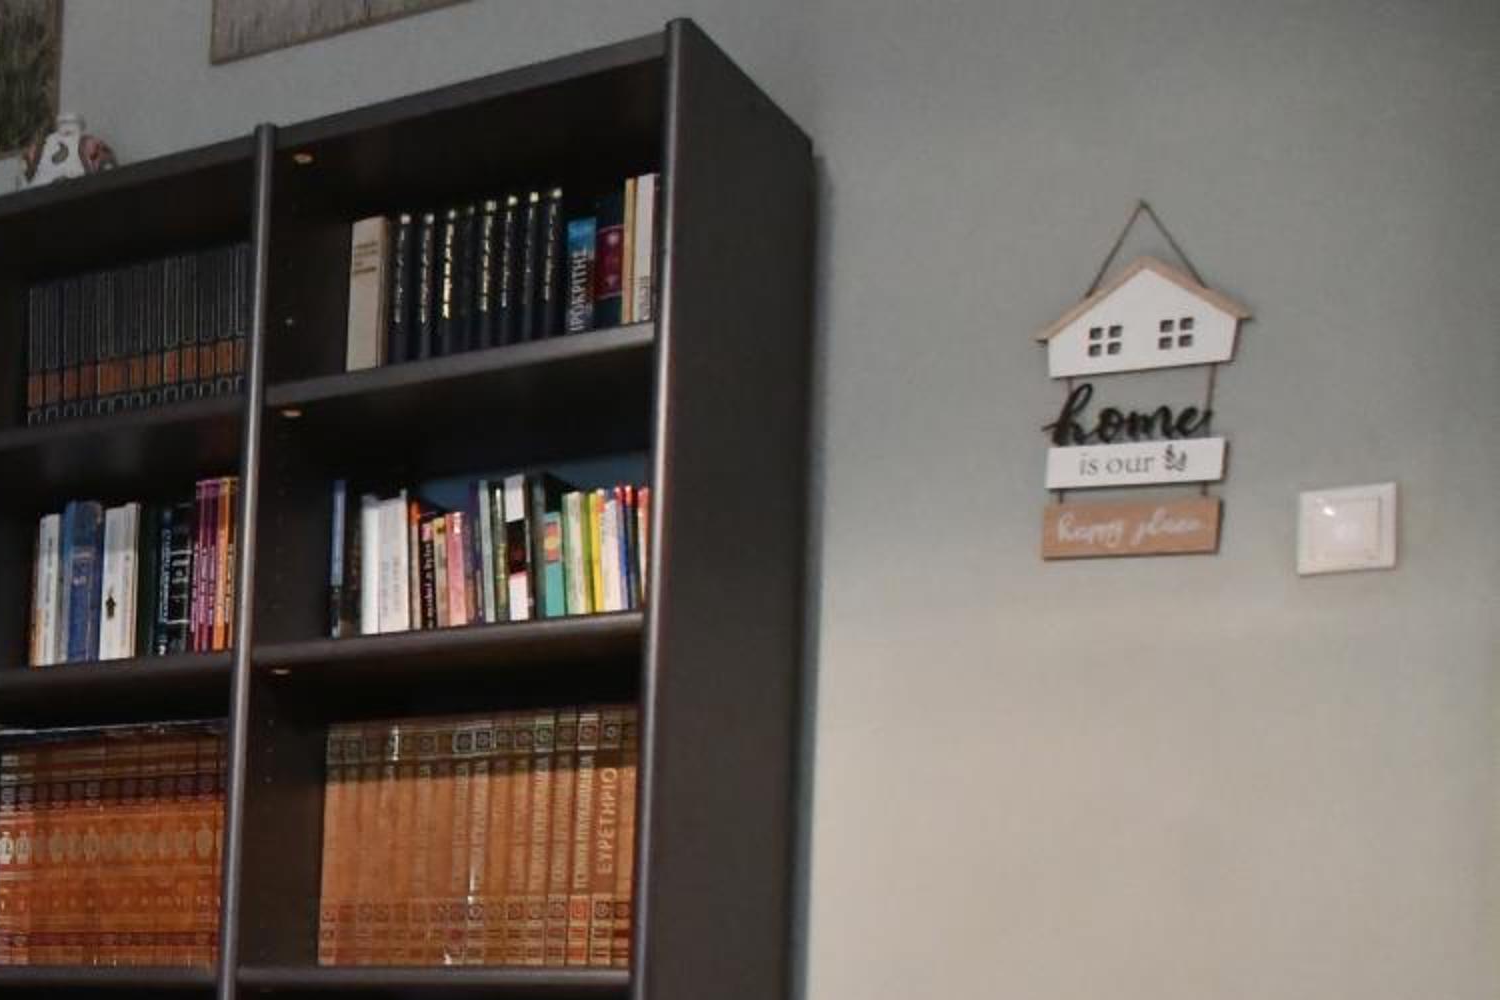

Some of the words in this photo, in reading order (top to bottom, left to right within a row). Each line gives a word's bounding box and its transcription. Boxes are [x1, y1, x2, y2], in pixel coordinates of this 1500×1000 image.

[1041, 383, 1212, 446] home
[1079, 453, 1099, 477] is
[1105, 455, 1156, 475] our
